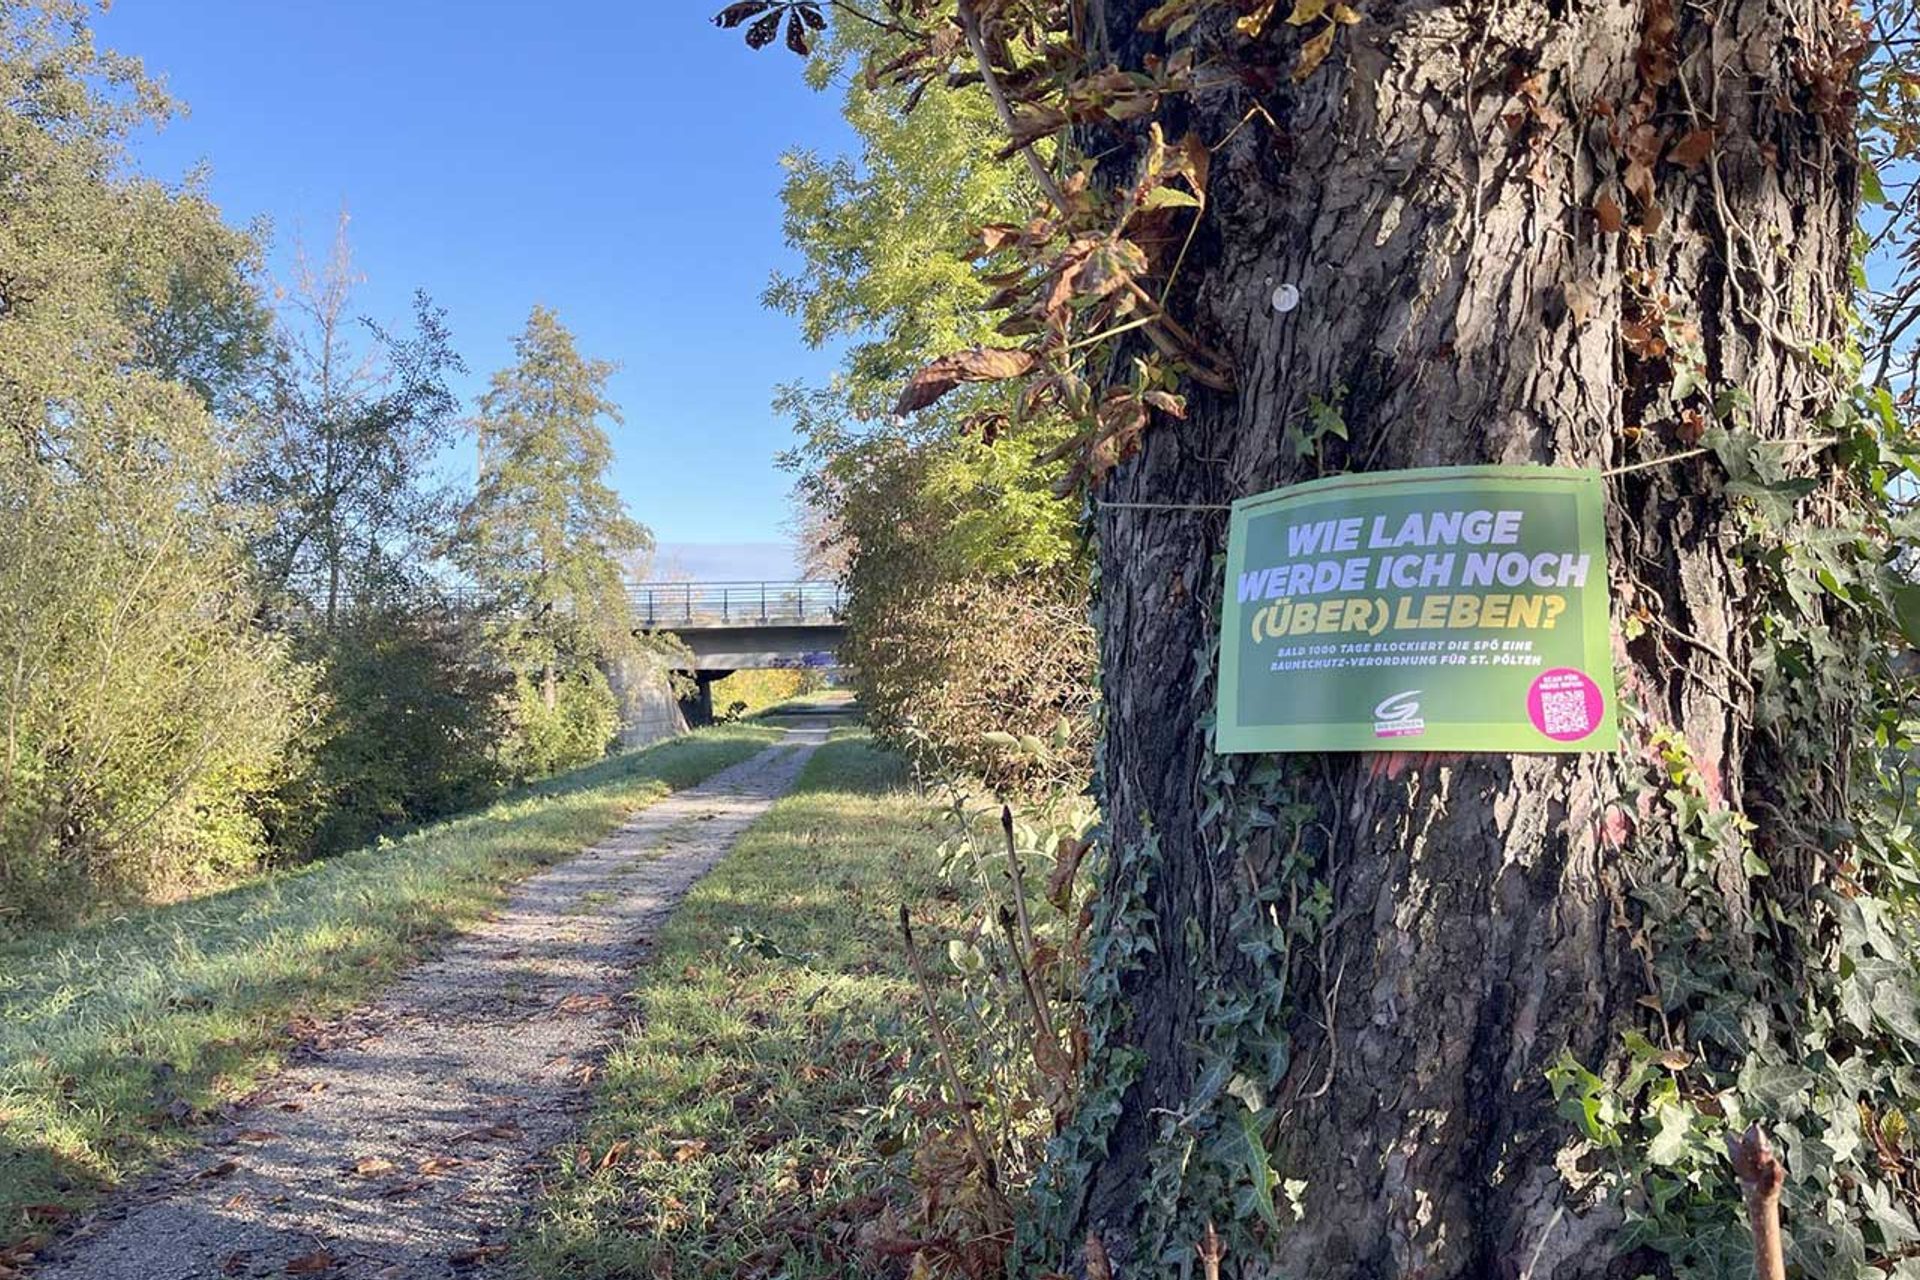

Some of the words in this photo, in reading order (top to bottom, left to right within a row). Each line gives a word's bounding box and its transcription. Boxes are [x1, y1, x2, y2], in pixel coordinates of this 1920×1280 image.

[1287, 517, 1363, 558] WIE
[1368, 511, 1523, 549] LANGE
[1238, 557, 1370, 603] WERDE
[1376, 554, 1456, 590] ICH
[1462, 552, 1591, 588] NOCH
[1251, 596, 1390, 644] (ÜBER)
[1394, 594, 1566, 631] LEBEN?
[1277, 645, 1306, 657] BALD
[1308, 644, 1337, 655] 1000
[1340, 642, 1371, 653] TAGE
[1374, 640, 1444, 652] BLOCKIERT
[1447, 640, 1469, 651] DIE
[1473, 638, 1499, 651] SPÖ
[1502, 640, 1533, 651] EINE
[1440, 654, 1467, 666] FÜR
[1470, 655, 1489, 665] ST.
[1492, 653, 1542, 666] PÖLTEN
